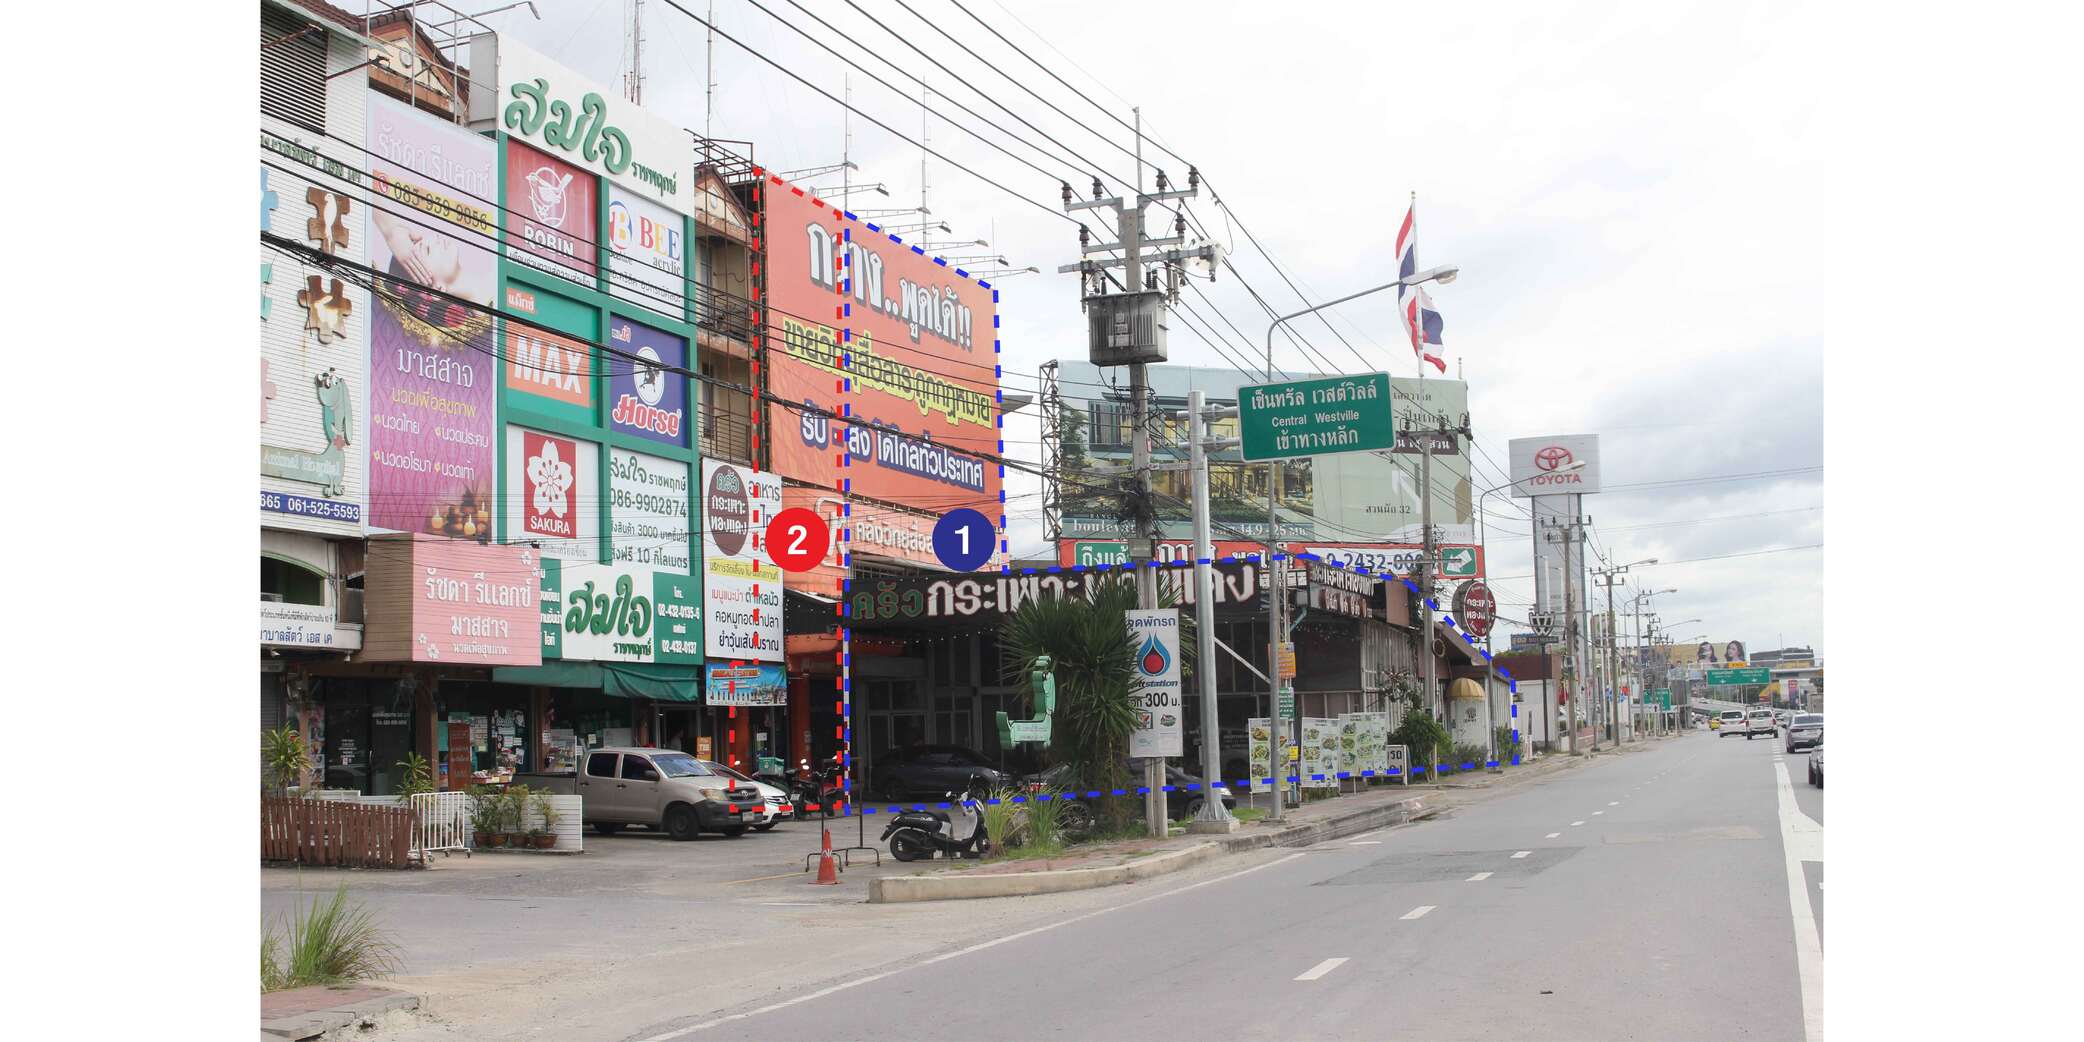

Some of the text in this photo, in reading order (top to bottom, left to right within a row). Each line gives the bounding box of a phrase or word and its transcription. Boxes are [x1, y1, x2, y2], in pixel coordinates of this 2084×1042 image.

[504, 77, 633, 175] สมใจ
[524, 224, 575, 260] ROBIN
[640, 215, 681, 261] BEE
[398, 348, 473, 388] มาสสาจ
[514, 333, 583, 395] MAX
[1251, 387, 1305, 410] เซ็นทรัล
[1312, 378, 1377, 404] เวสต์วิลล์
[382, 412, 421, 435] นวดไทย
[612, 394, 679, 437] Horse
[1271, 410, 1360, 428] Central Westville
[1276, 424, 1359, 450] เข้าทางหลัก
[381, 450, 432, 474] นวดอโรมา
[1530, 474, 1581, 486] TOYOTA
[288, 498, 360, 519] 061-525-5593
[530, 515, 571, 534] SAKURA
[637, 548, 650, 564] 10
[653, 548, 688, 569] กิโลเมตร
[425, 567, 469, 603] รัชดา
[474, 572, 532, 607] รีแลกซ์
[565, 574, 652, 638] สมใจ
[260, 626, 303, 642] าบาลสัตว์
[451, 616, 508, 638] มาสสาจ
[1145, 693, 1168, 707] 300
